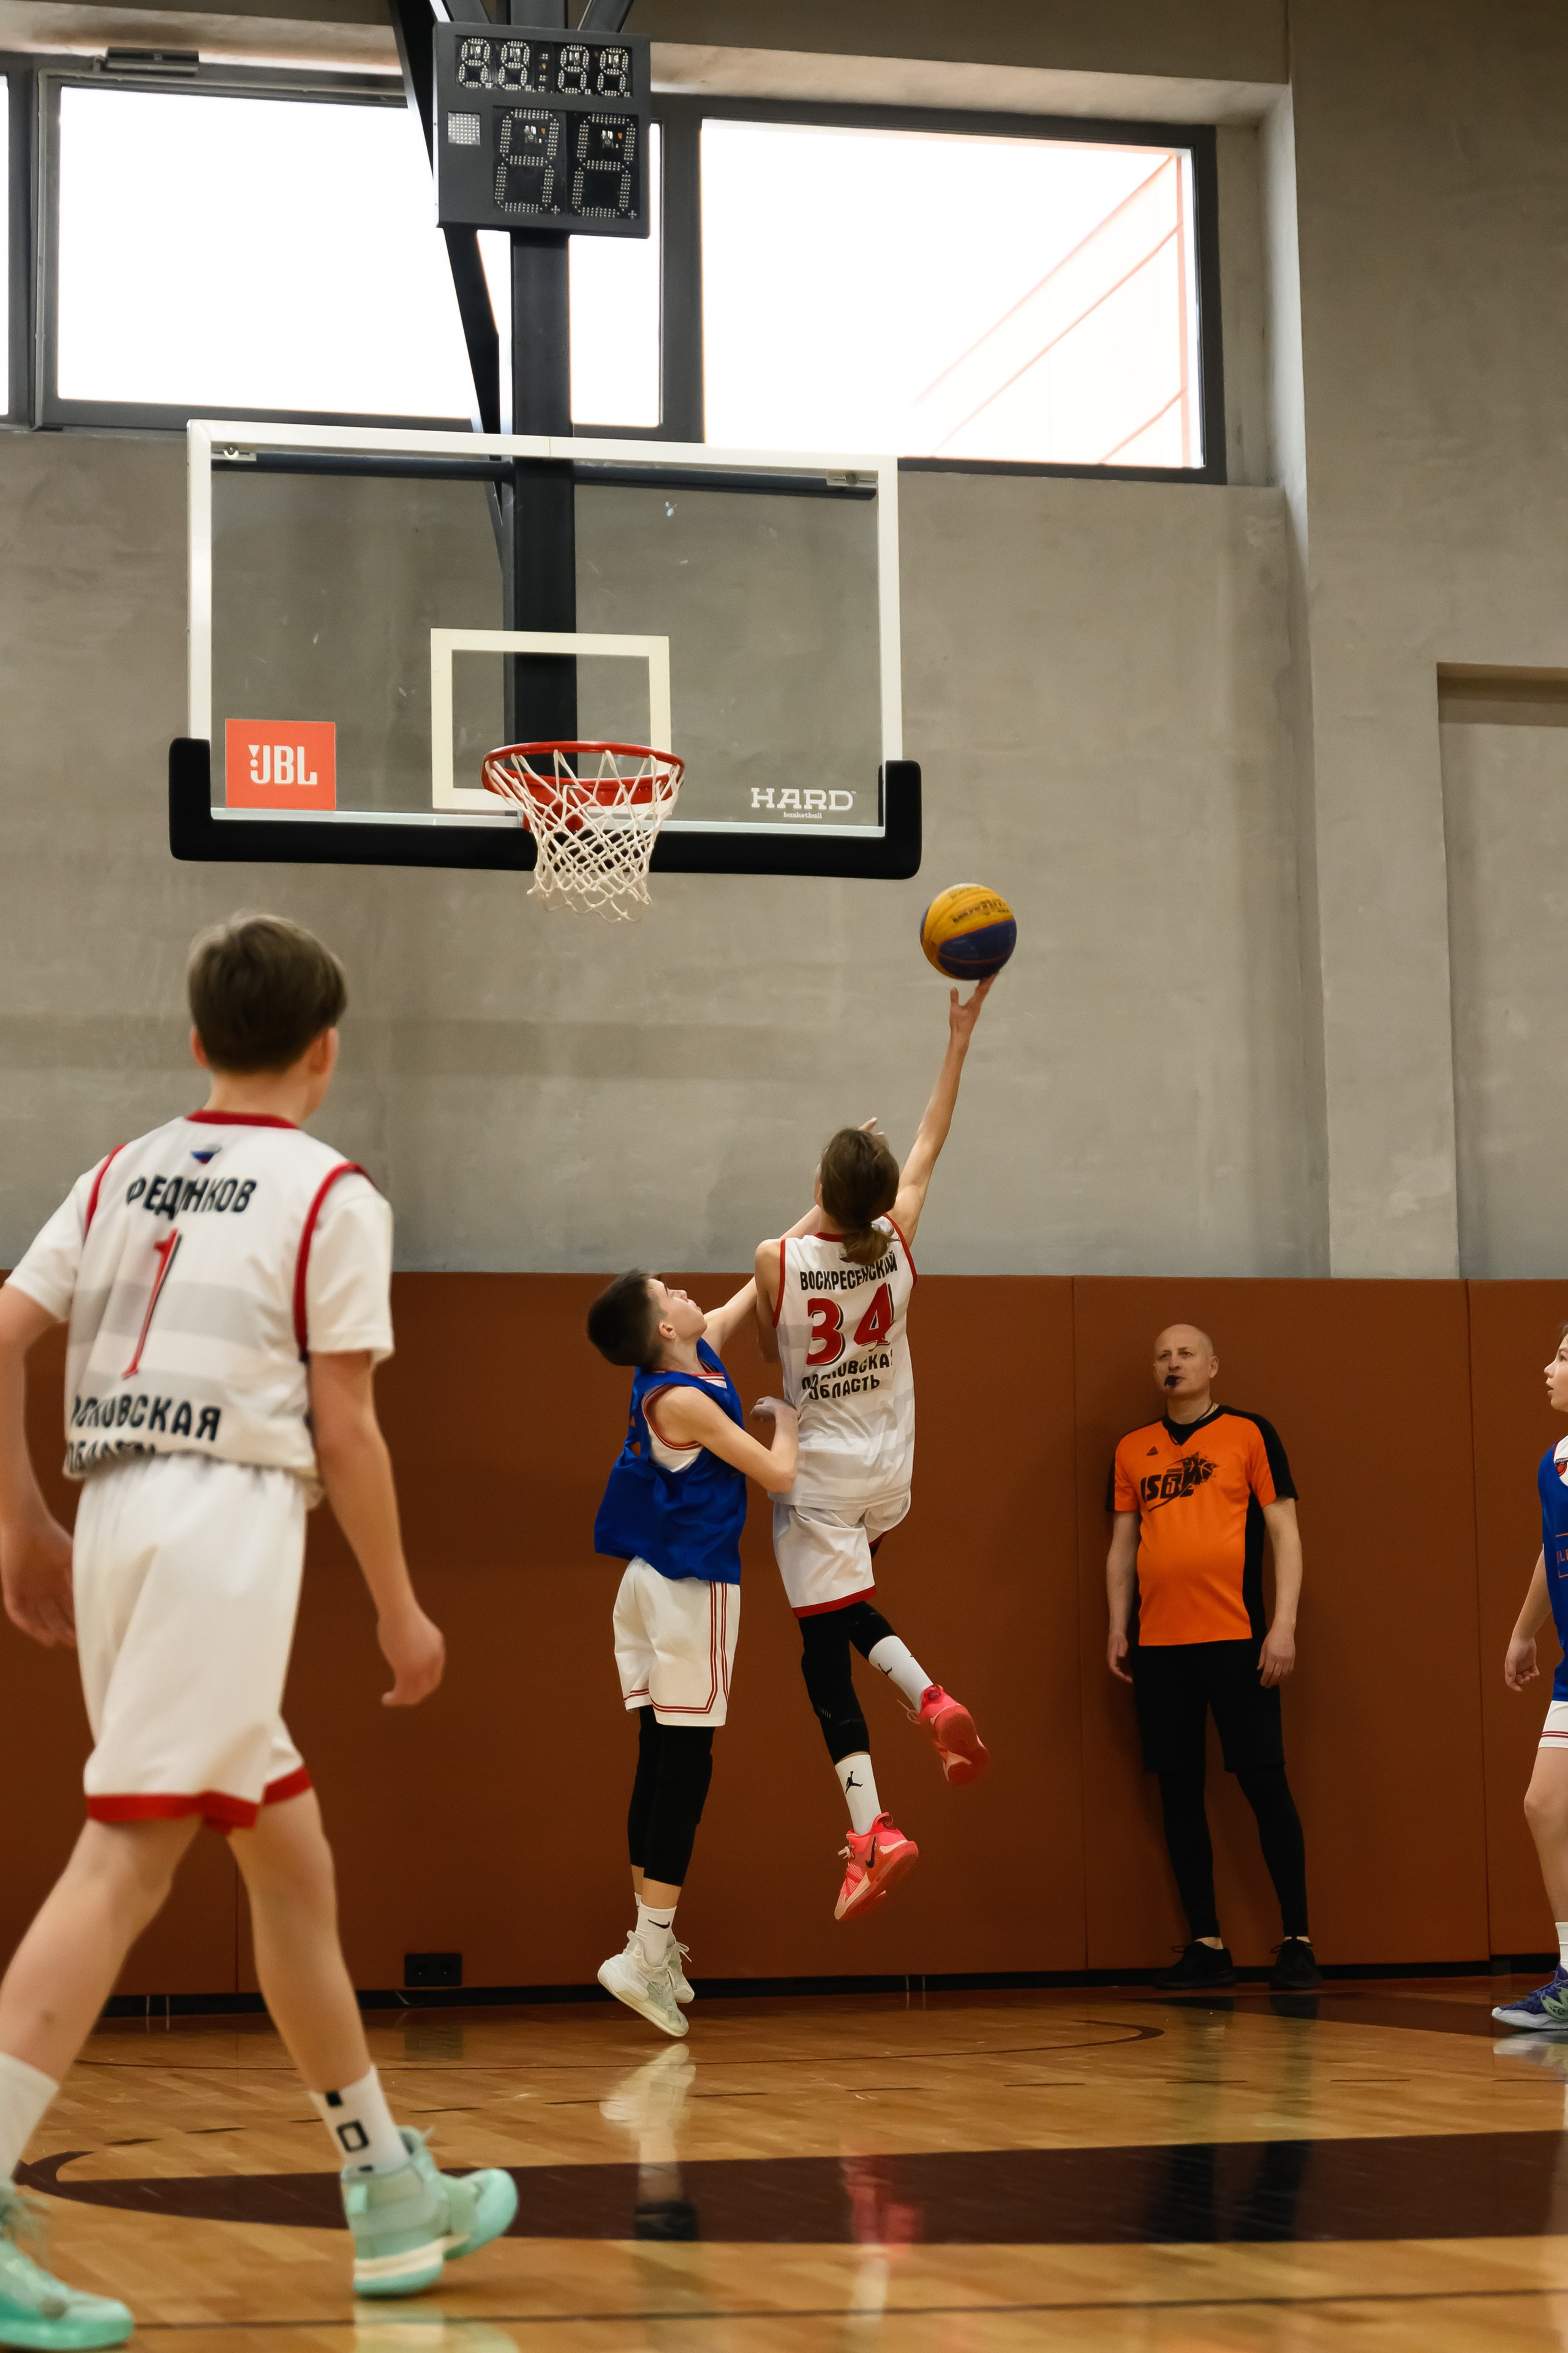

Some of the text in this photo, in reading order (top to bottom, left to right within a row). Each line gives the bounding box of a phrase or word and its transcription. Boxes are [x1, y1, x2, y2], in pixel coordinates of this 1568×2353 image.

[248, 744, 317, 785] JBL
[122, 1227, 183, 1380] 1
[805, 1282, 897, 1367] 34
